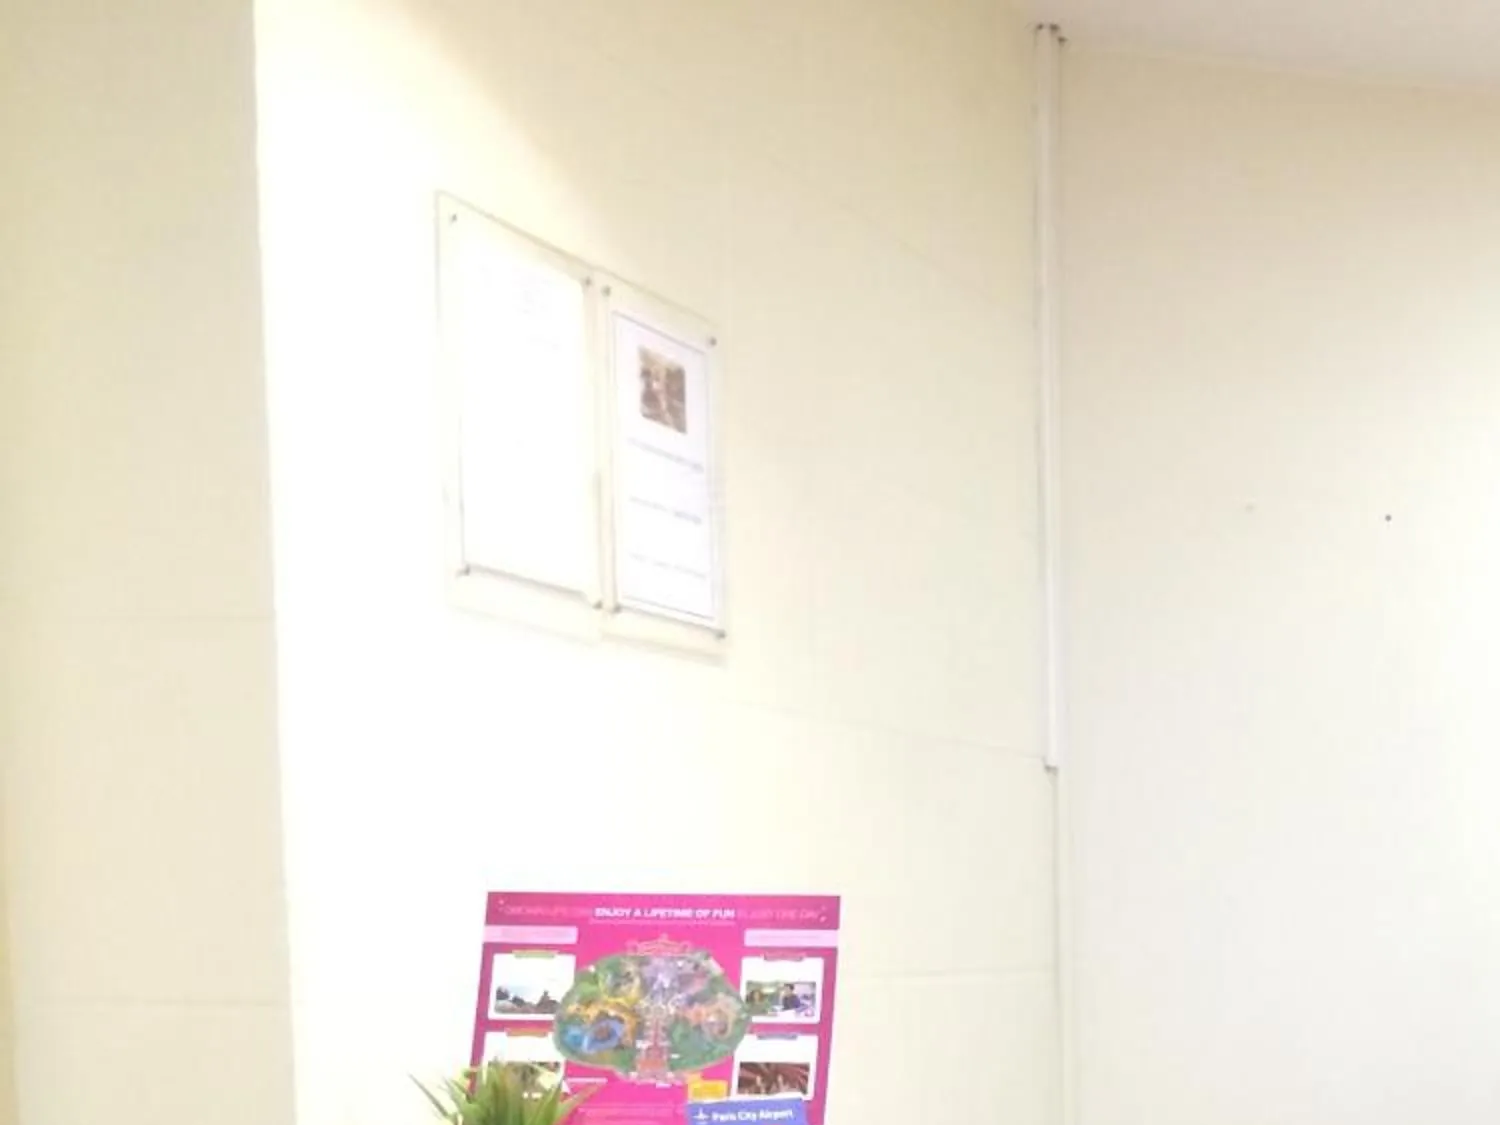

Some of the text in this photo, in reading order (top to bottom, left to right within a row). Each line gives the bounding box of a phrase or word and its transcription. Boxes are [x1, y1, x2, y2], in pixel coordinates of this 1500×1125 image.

[595, 907, 632, 918] ENJOY
[643, 907, 693, 919] LIFETIME
[695, 908, 711, 918] OF
[712, 908, 736, 918] FUN
[711, 1109, 794, 1123] Paris City Airport
